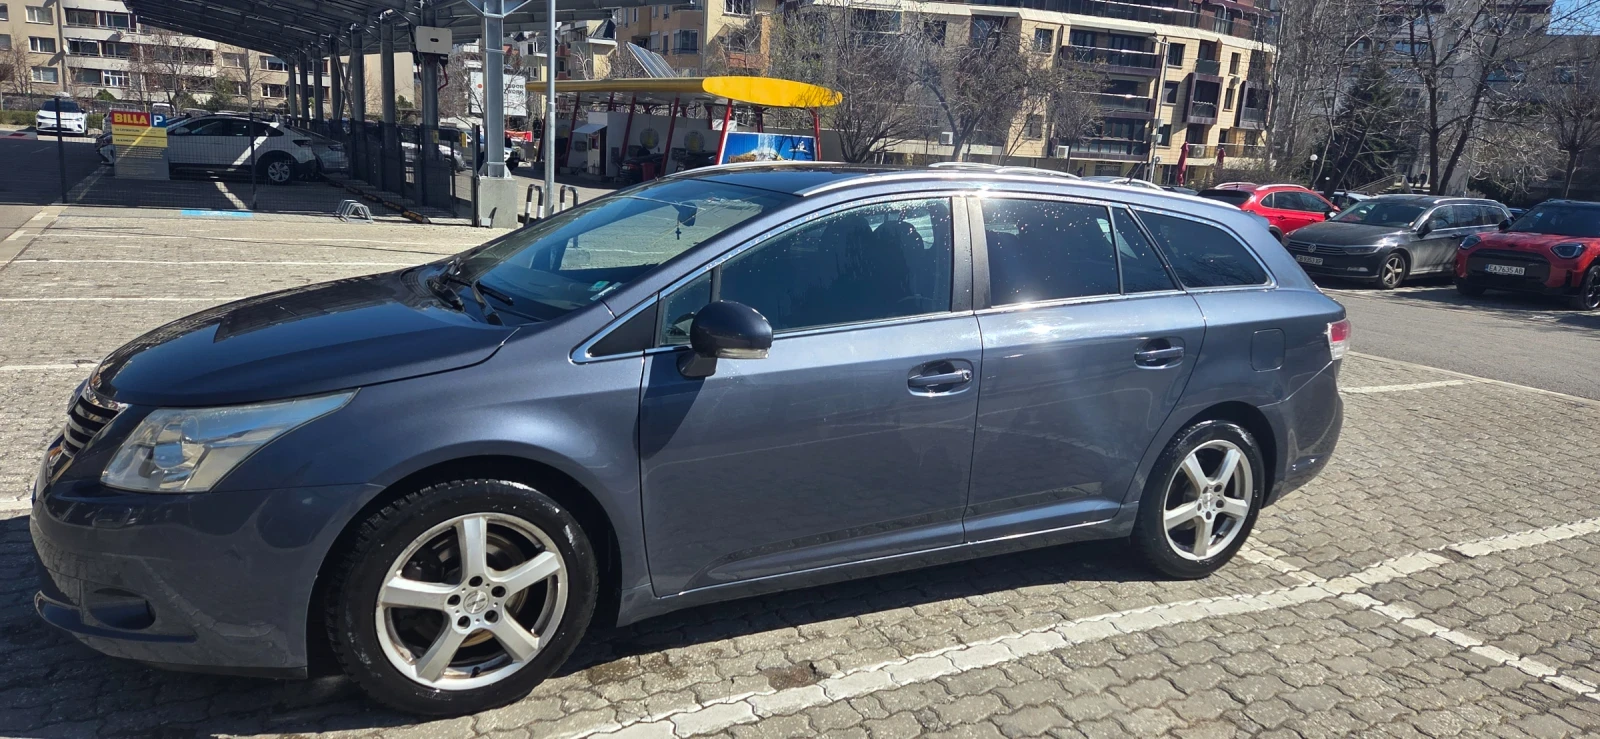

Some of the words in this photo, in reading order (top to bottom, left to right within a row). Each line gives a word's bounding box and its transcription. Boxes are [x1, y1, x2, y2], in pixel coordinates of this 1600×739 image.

[113, 113, 148, 125] BILLA
[153, 114, 164, 126] P
[1489, 264, 1498, 272] EA
[1498, 265, 1514, 273] 7635
[1514, 267, 1524, 275] AB
